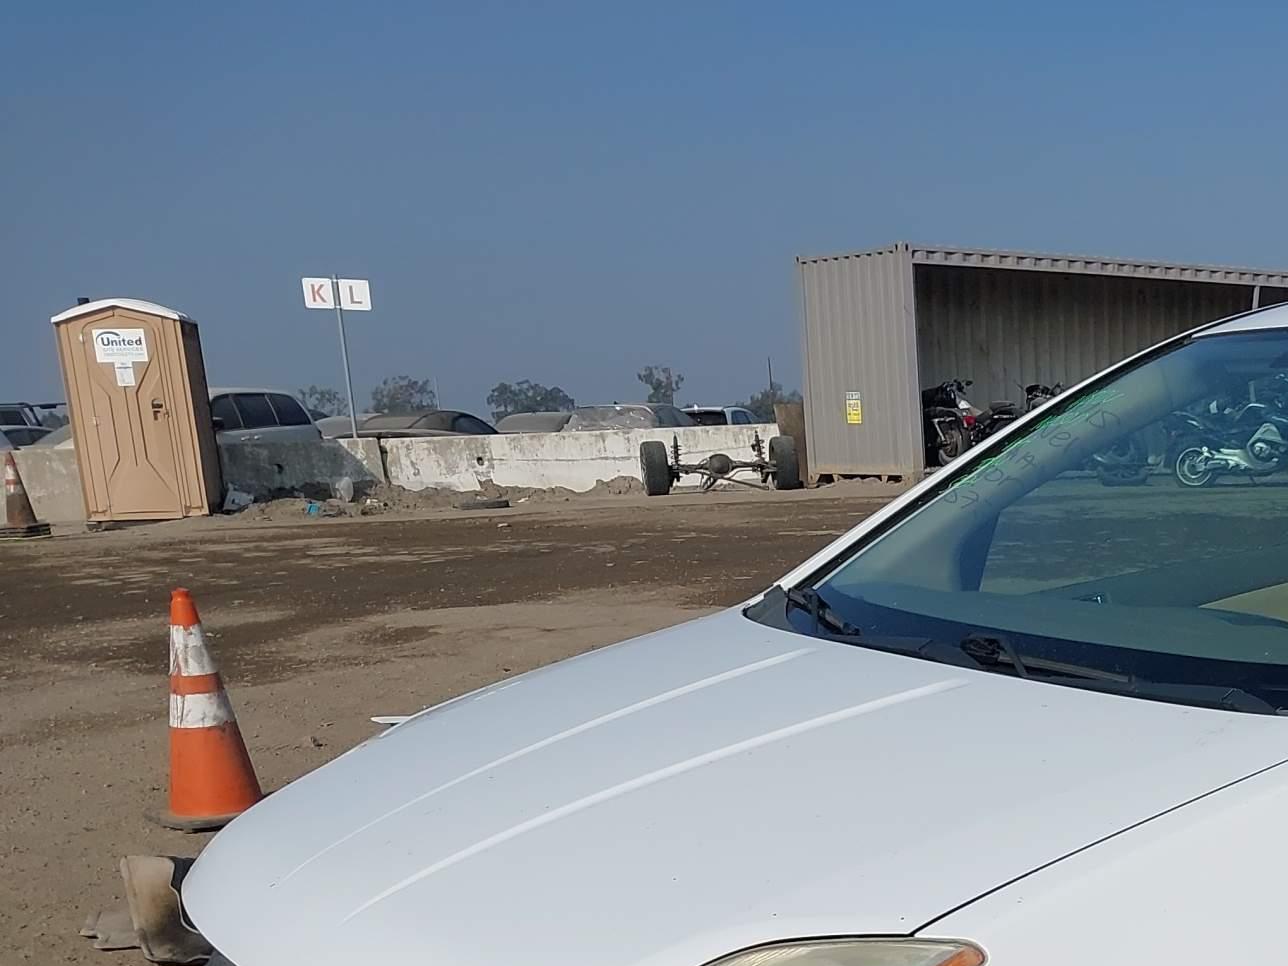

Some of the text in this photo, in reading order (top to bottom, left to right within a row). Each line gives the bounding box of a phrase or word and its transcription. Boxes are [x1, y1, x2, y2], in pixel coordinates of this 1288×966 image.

[310, 283, 327, 303] K
[348, 285, 363, 304] L
[101, 337, 142, 346] United
